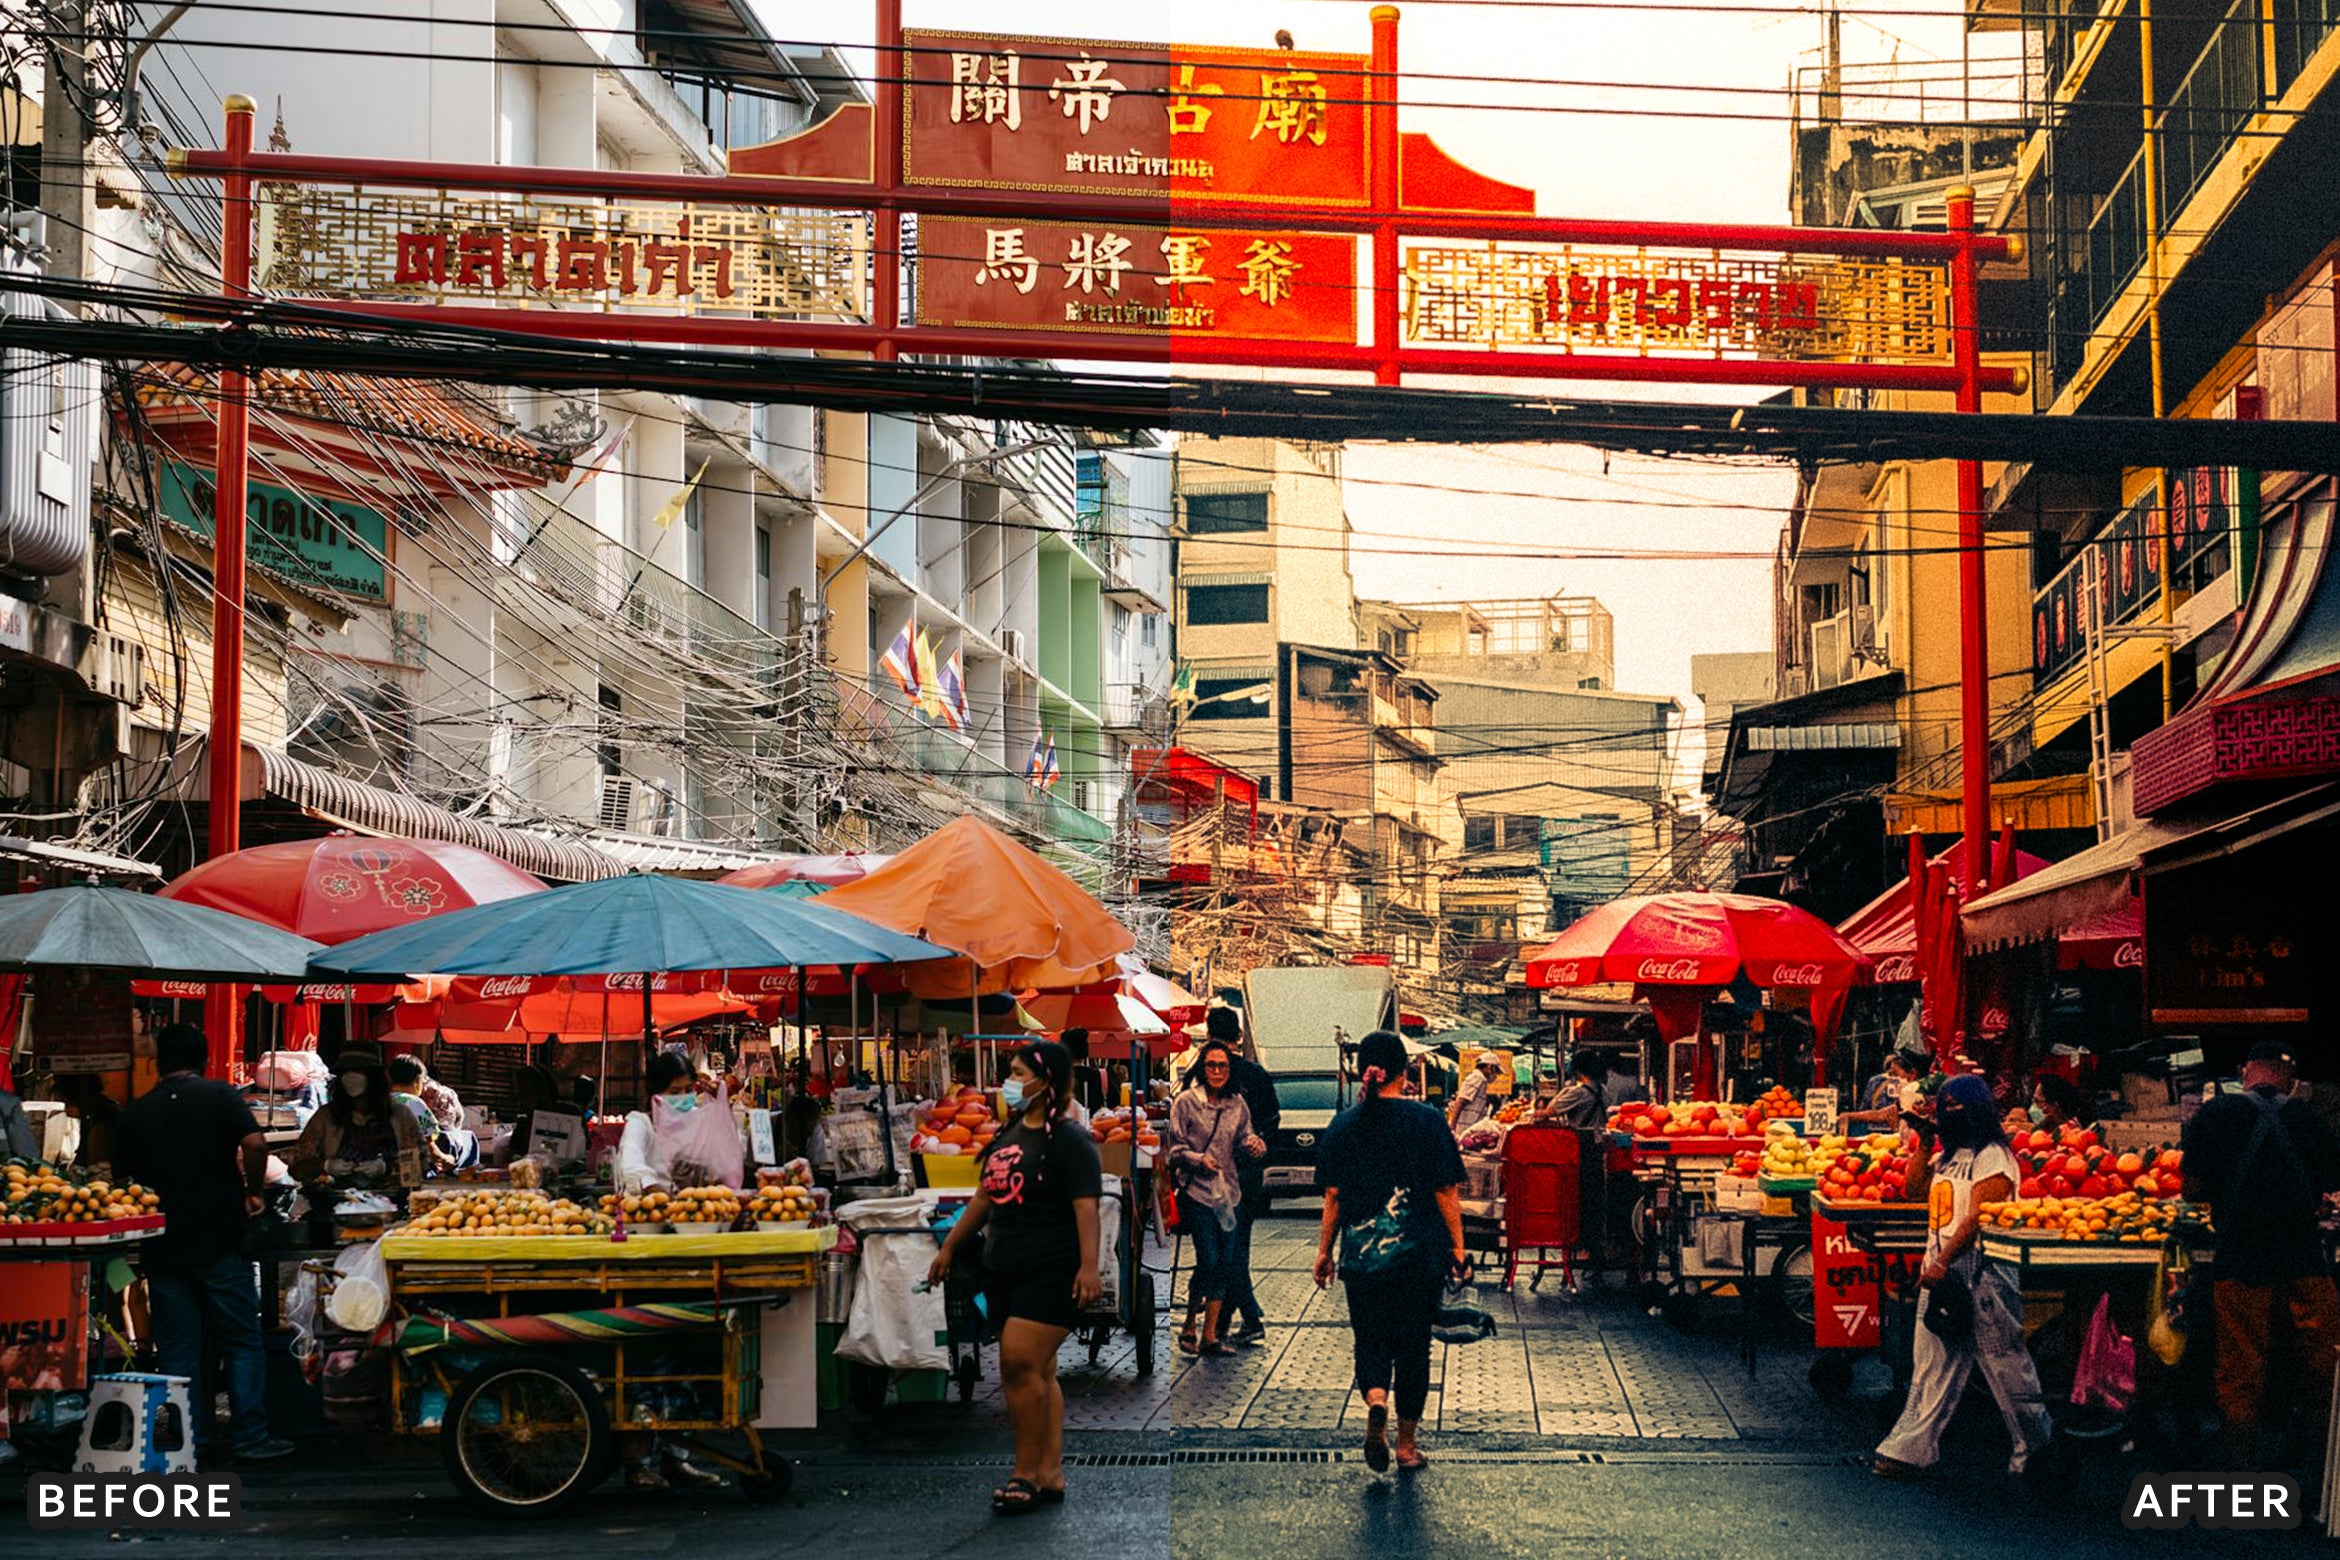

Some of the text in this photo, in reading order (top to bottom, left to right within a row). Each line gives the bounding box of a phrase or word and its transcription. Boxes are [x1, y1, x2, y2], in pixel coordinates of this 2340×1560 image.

[950, 49, 1327, 146] 關帝古廟
[394, 215, 735, 299] ตลาดเก่า
[974, 227, 1304, 307] 馬將軍爺
[1544, 273, 1821, 330] เยาวราช
[480, 976, 532, 999] Coca-Cola
[1545, 962, 1580, 983] Coca-Cola
[1644, 957, 1701, 980] Coca-Cola
[1772, 963, 1824, 985] Coca-Cola
